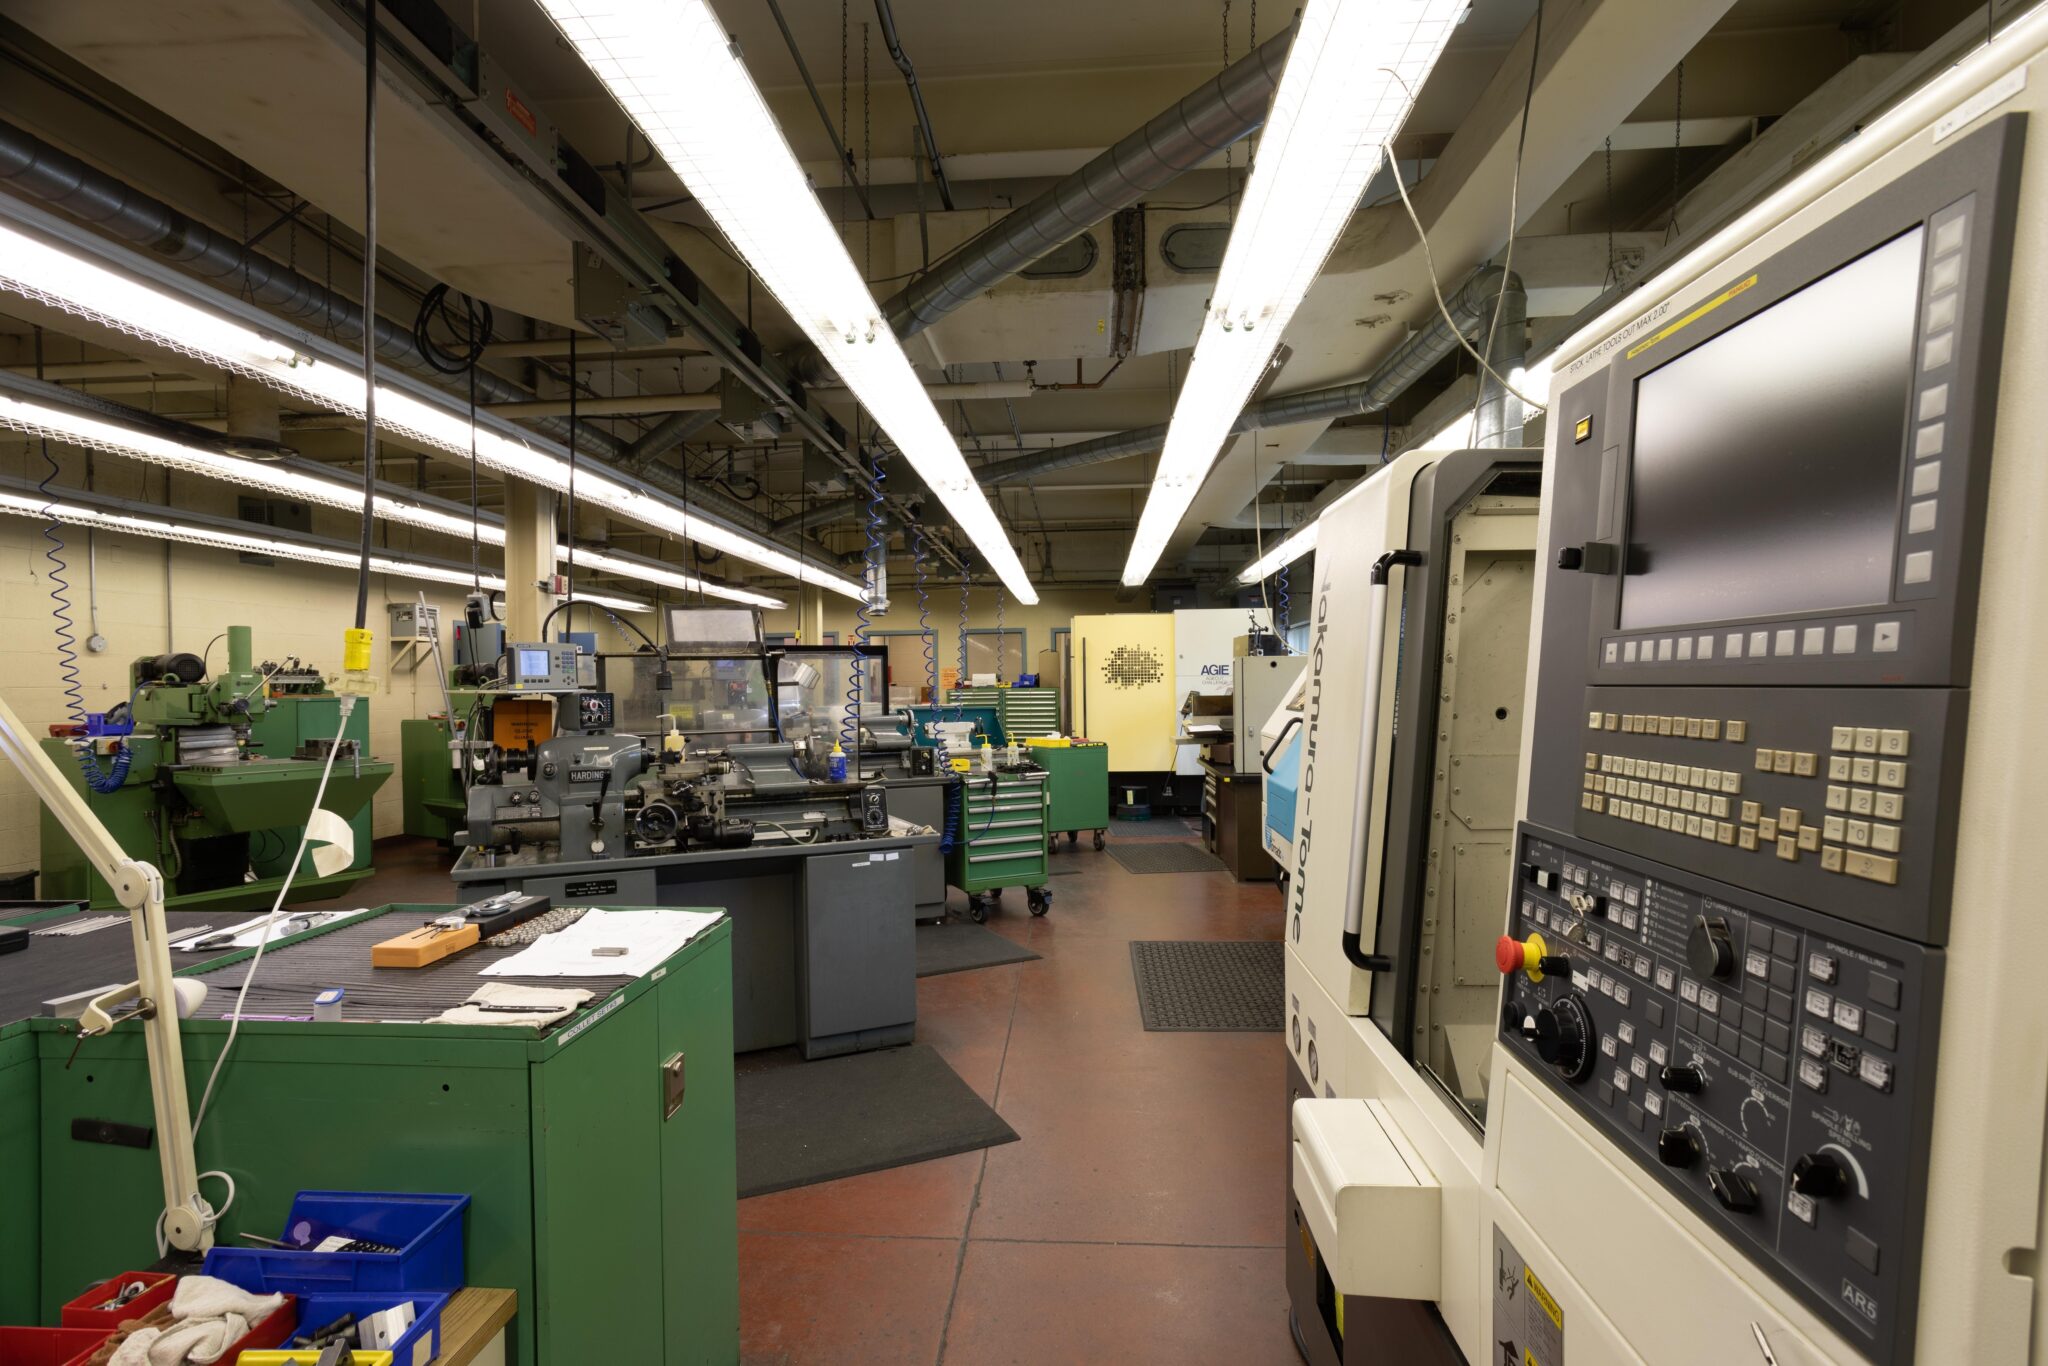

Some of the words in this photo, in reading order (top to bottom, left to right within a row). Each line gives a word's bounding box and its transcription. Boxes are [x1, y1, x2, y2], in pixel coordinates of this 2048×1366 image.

[1586, 346, 1602, 363] LATHE
[1603, 333, 1621, 352] TOOLS
[1622, 325, 1635, 339] OUT
[1636, 314, 1653, 329] MAX
[1201, 664, 1229, 676] AGIE
[1840, 733, 1849, 745] 7
[1863, 735, 1873, 748] 8
[1889, 737, 1899, 750] 9
[571, 771, 609, 781] HARDING
[1837, 764, 1845, 776] 4
[1861, 765, 1870, 778] 5
[1887, 768, 1897, 781] 6
[1835, 793, 1841, 805] 1
[1858, 797, 1868, 809] 2
[1884, 801, 1893, 814] 3
[1856, 828, 1865, 841] 0
[567, 1014, 596, 1038] COLLET
[1828, 1129, 1851, 1148] SPEED
[1844, 1285, 1877, 1319] AR5
